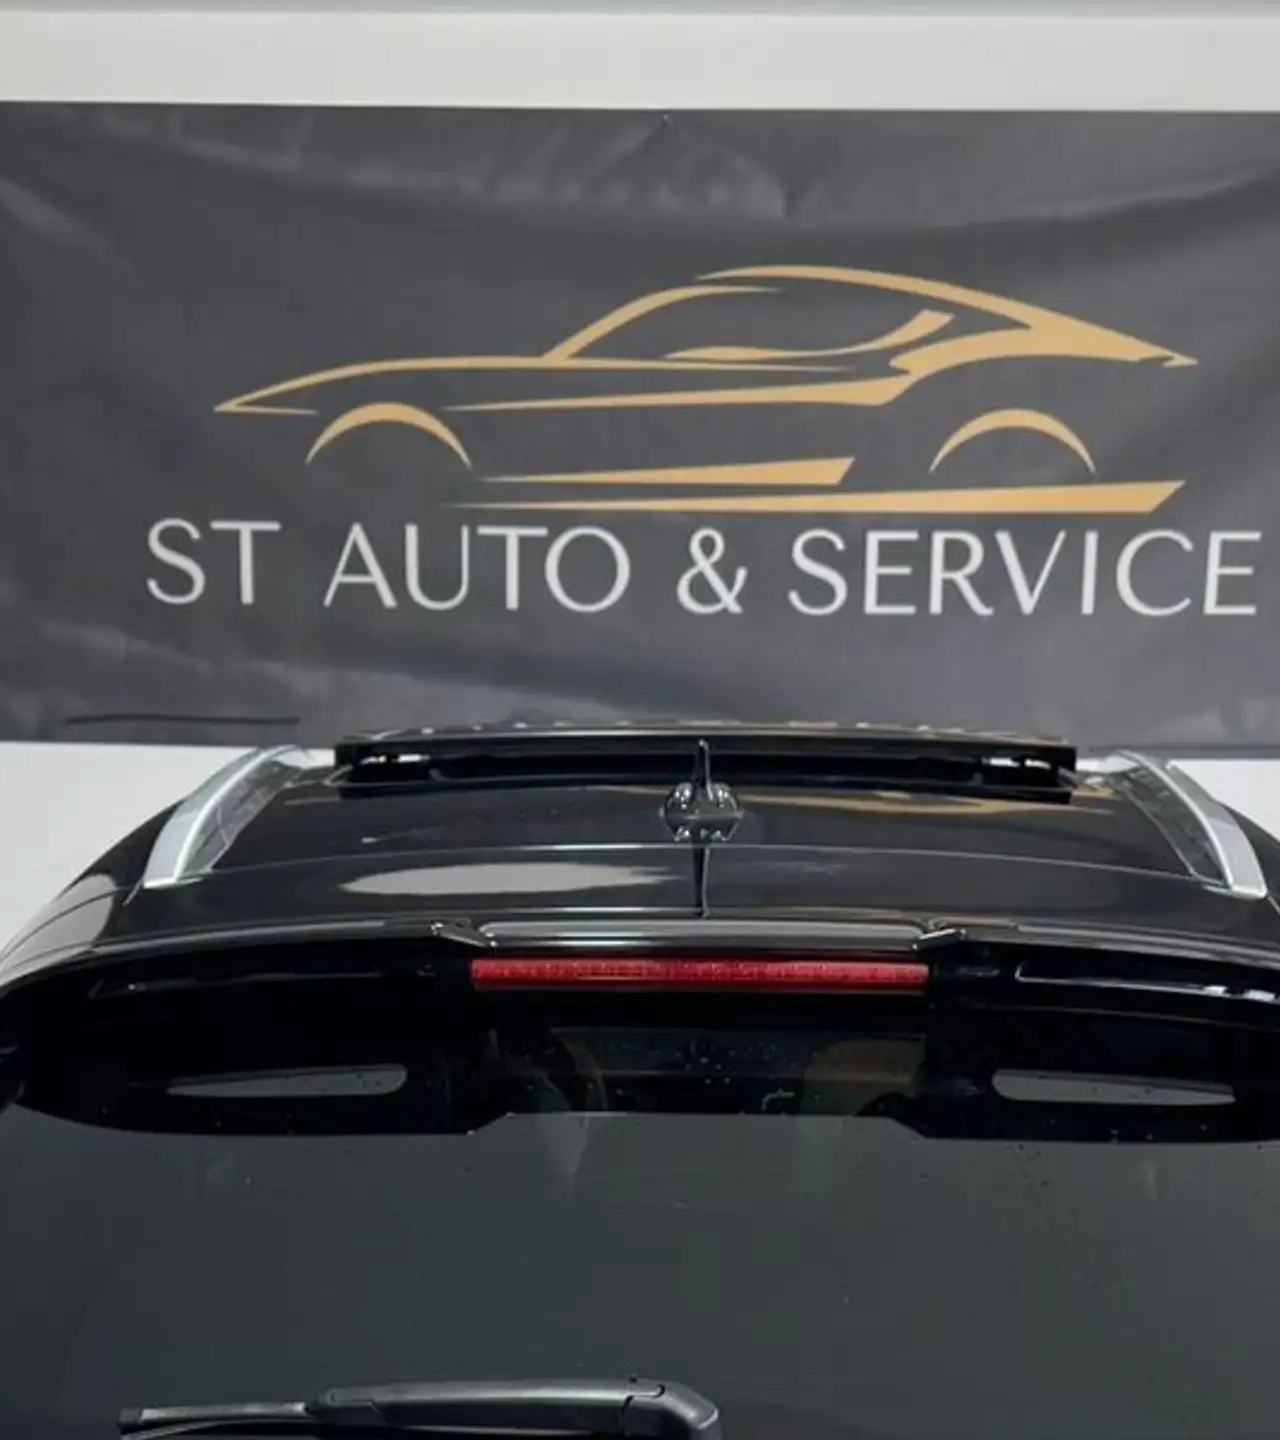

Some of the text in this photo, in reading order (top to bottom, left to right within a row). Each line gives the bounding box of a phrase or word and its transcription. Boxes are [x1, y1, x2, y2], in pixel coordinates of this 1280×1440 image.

[145, 518, 1263, 617] ST AUTO & SERVICE
